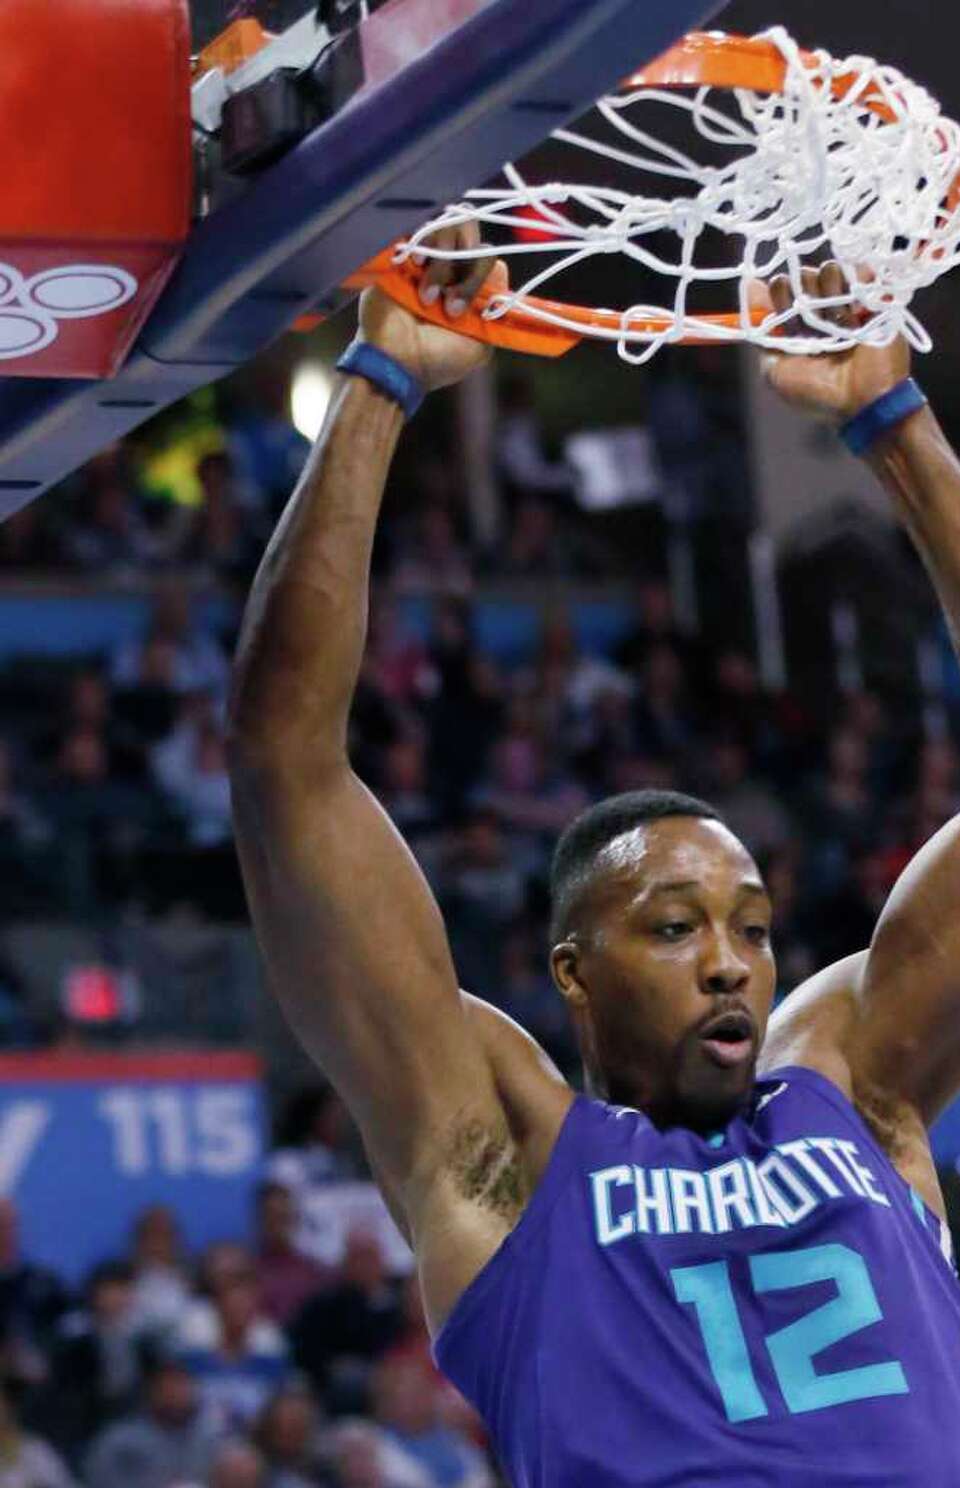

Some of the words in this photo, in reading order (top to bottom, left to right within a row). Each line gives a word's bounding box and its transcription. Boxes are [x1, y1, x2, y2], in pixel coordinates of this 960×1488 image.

[102, 1088, 258, 1175] 115
[588, 1136, 892, 1247] CHARLOTTE
[669, 1243, 910, 1424] 12
